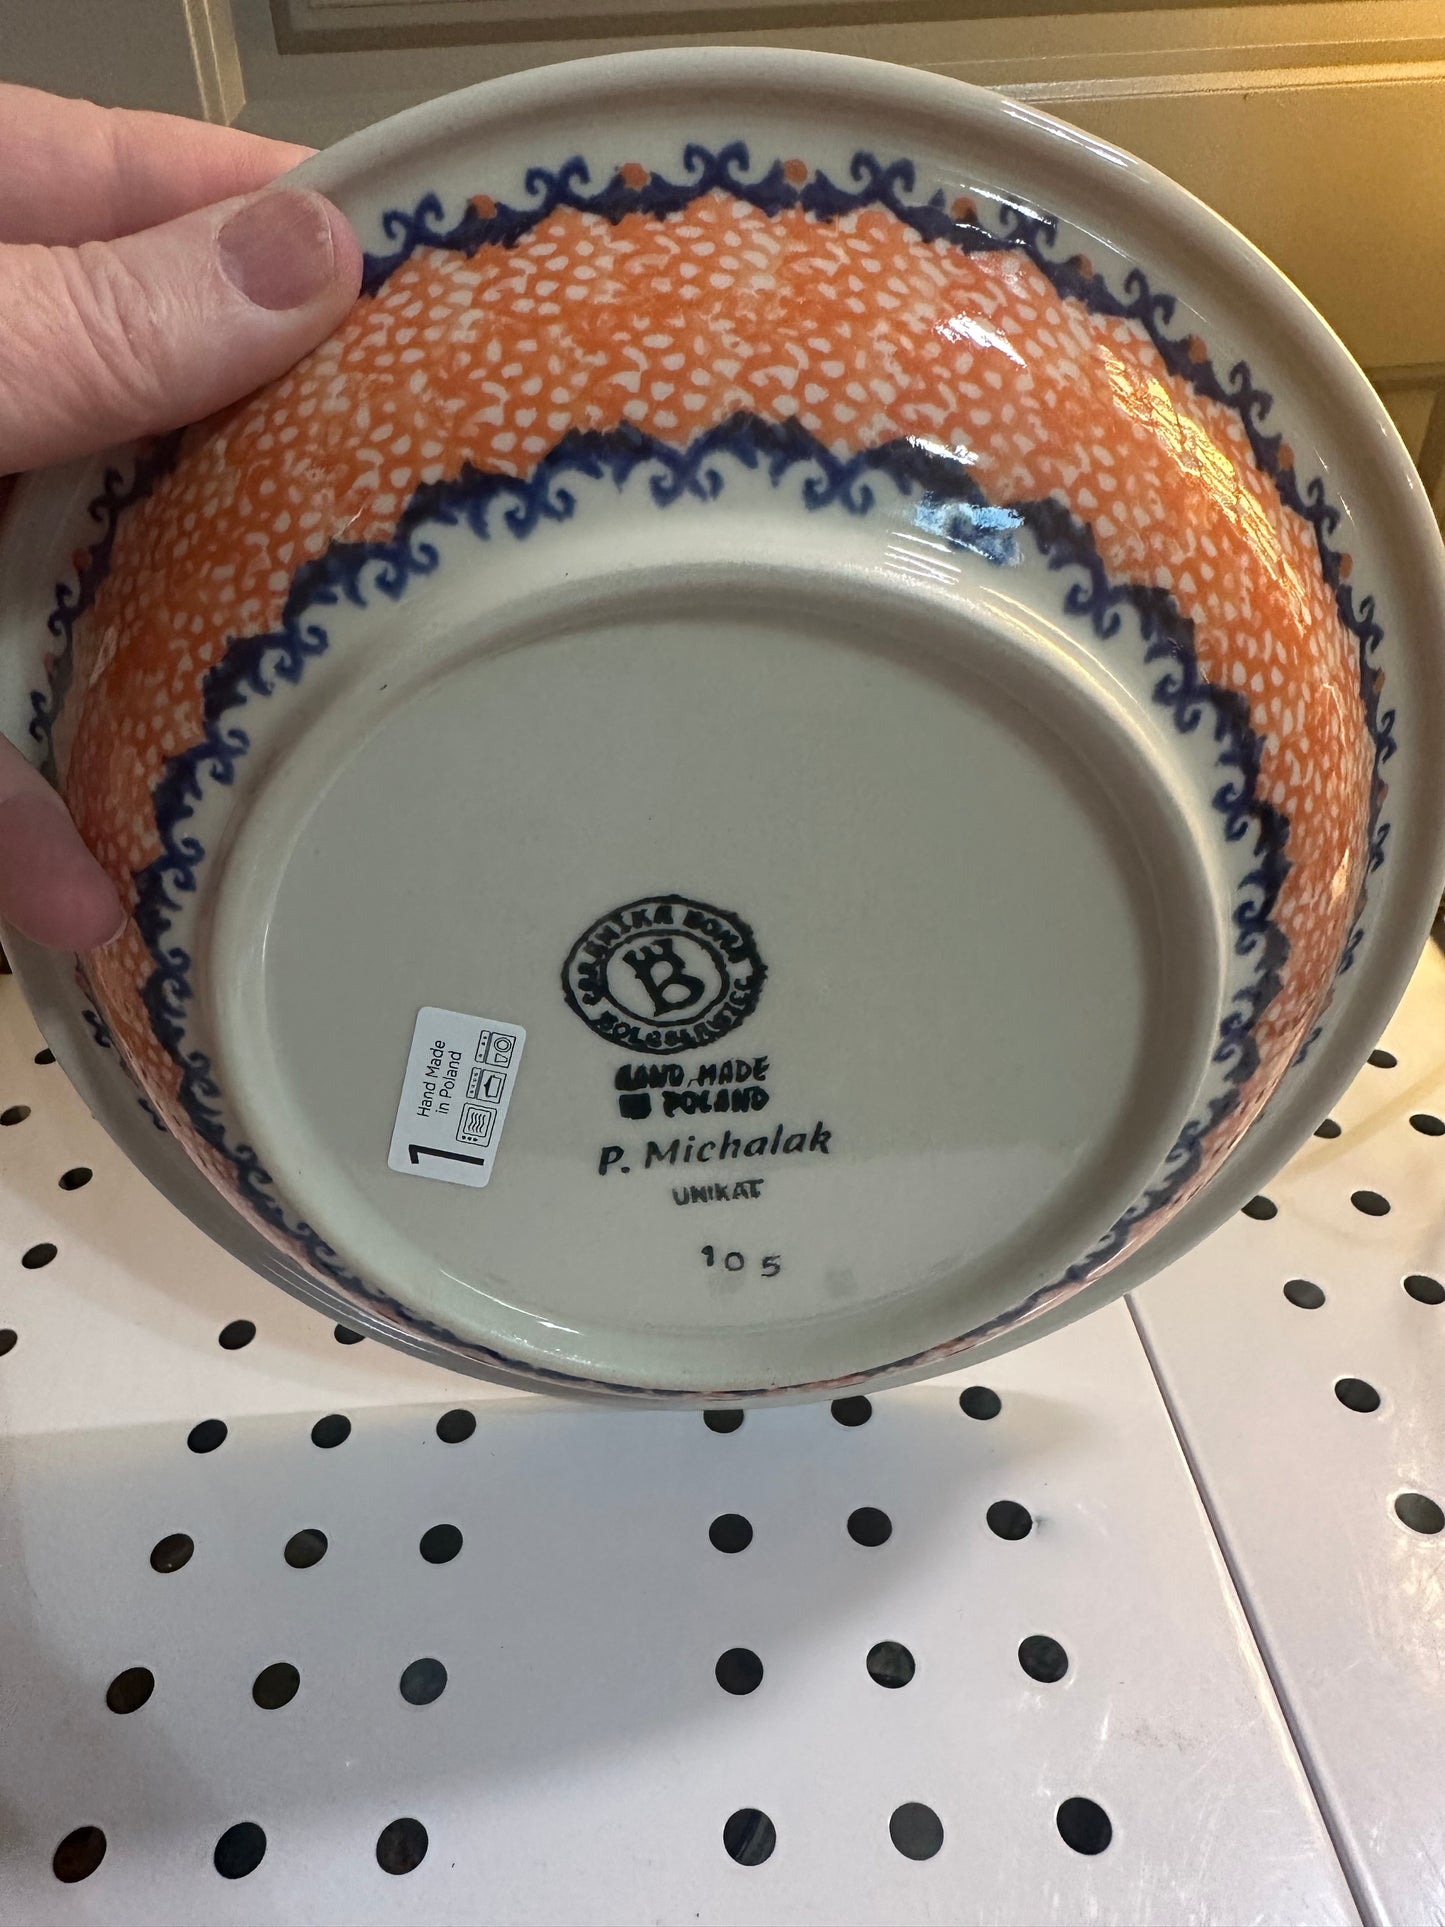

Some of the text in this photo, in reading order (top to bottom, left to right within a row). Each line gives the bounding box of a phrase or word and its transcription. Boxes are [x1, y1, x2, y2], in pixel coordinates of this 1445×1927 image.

[624, 940, 706, 1018] B
[416, 1039, 446, 1118] Hand Made
[435, 1050, 462, 1115] in Poland
[662, 1085, 770, 1118] POLAND
[408, 1143, 485, 1166] 1
[598, 1120, 832, 1176] P. Michalak
[672, 1178, 765, 1206] UNIKAT
